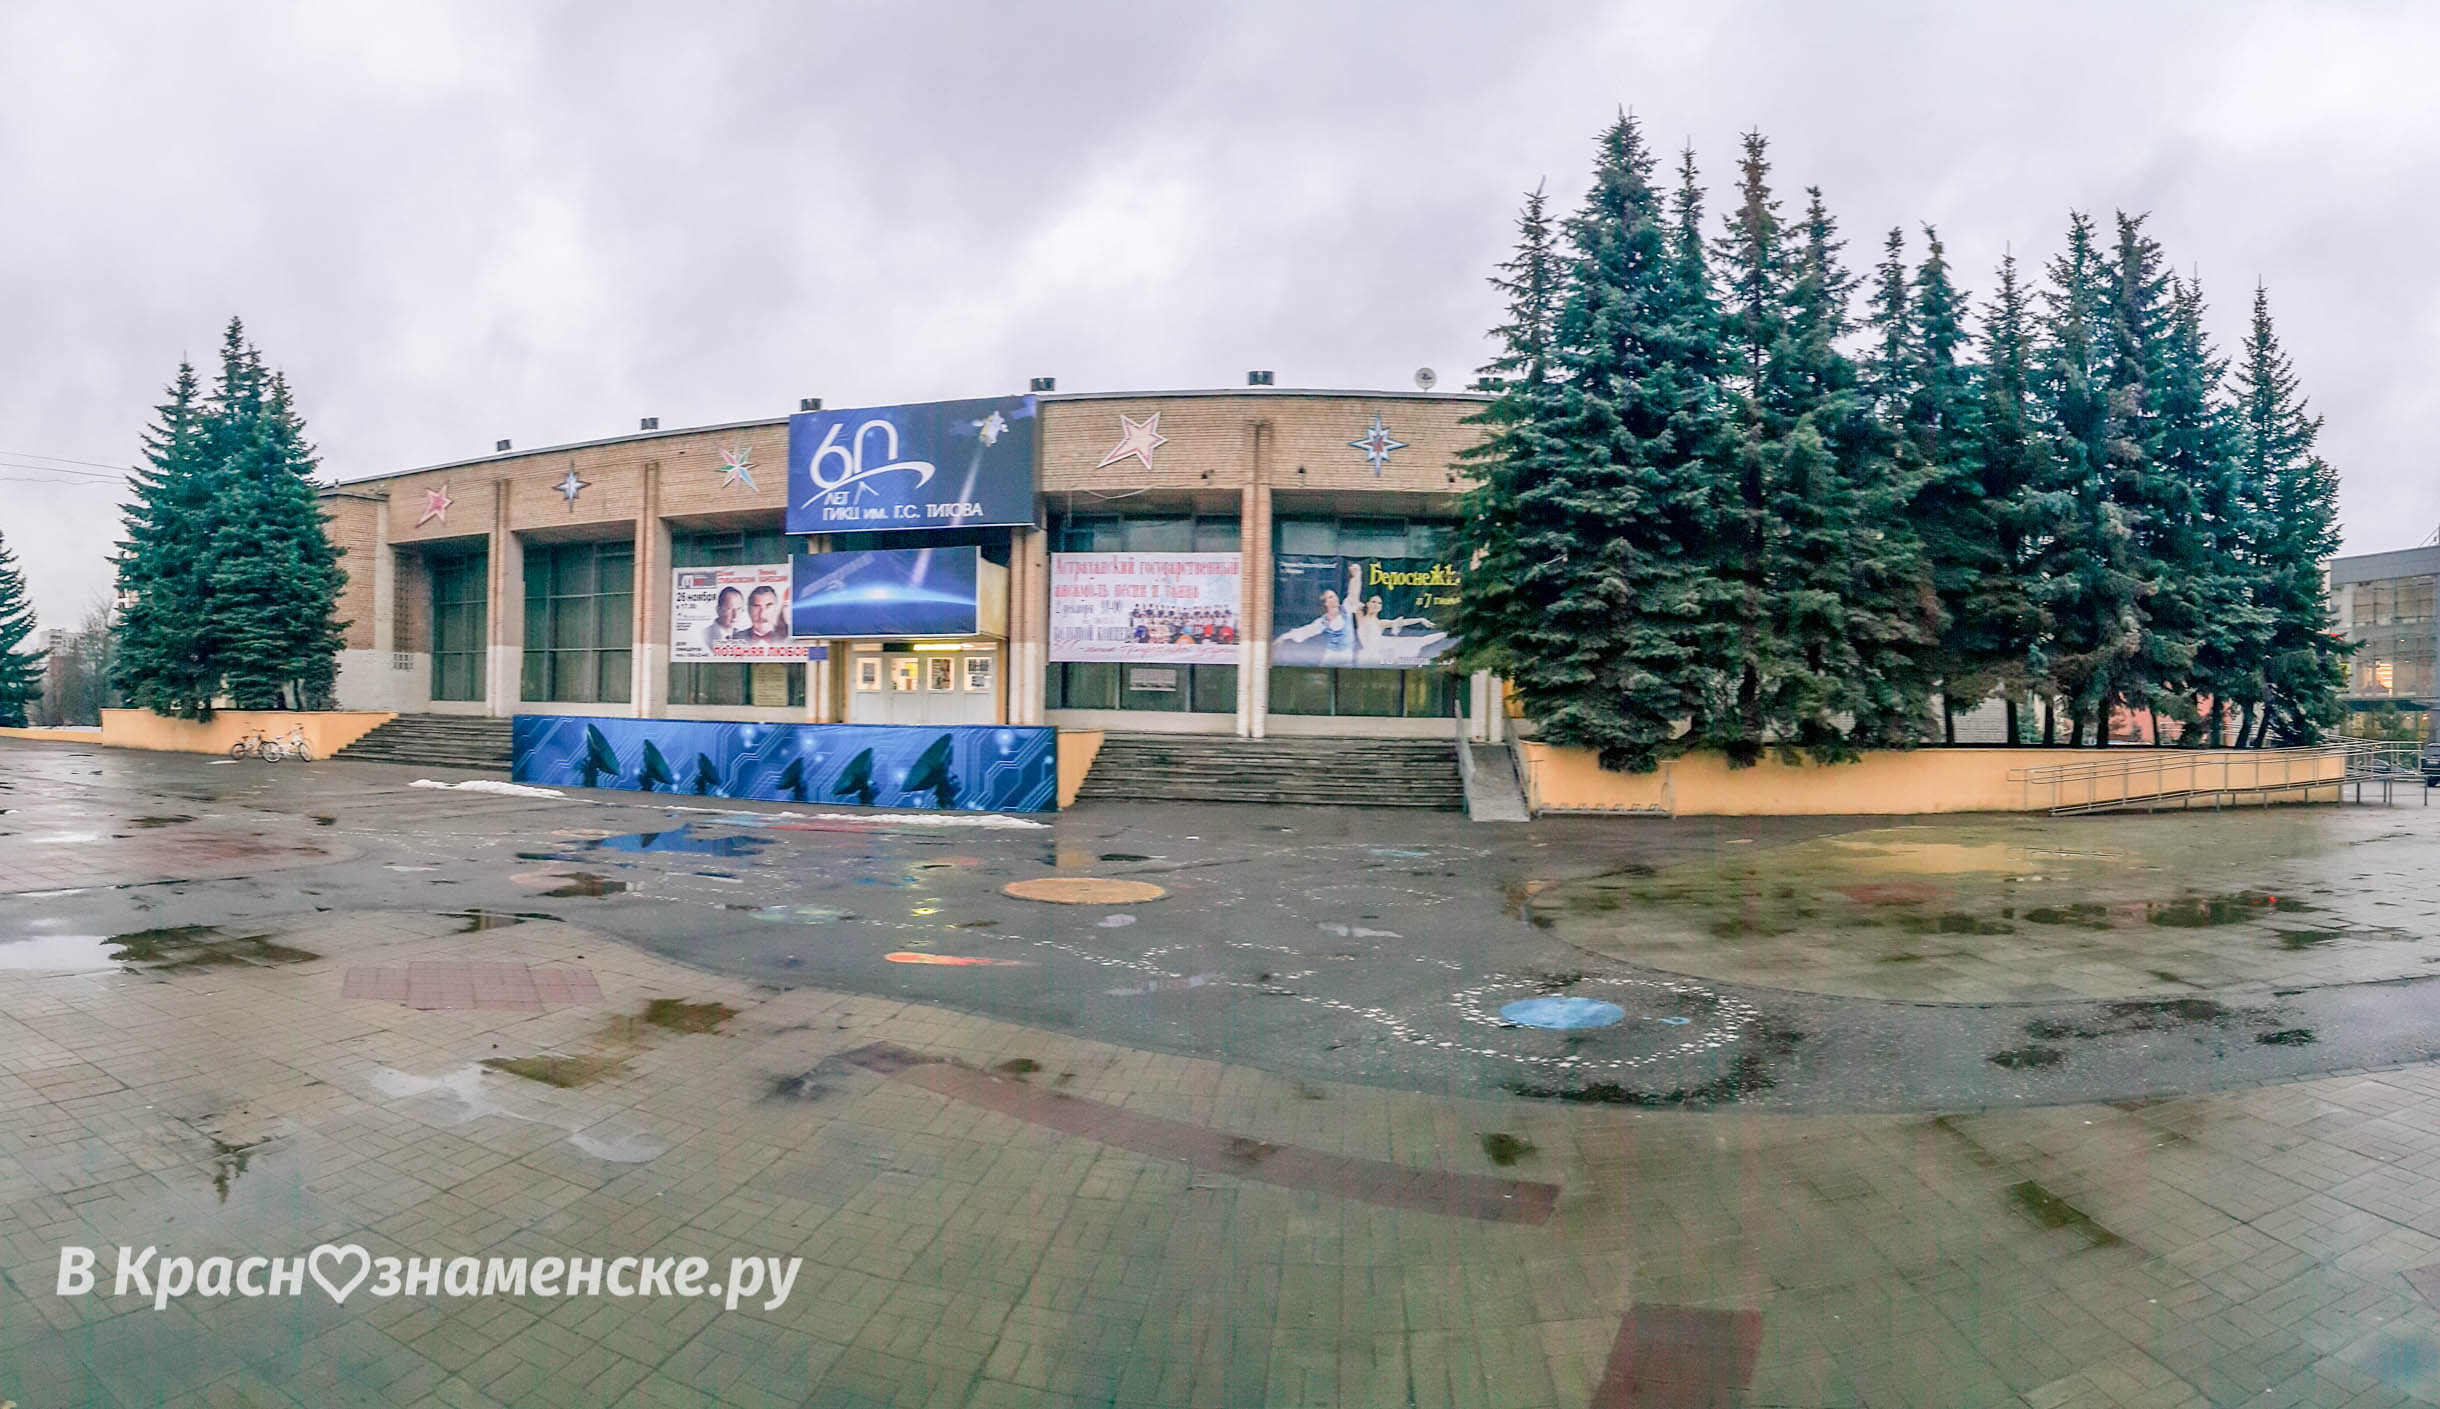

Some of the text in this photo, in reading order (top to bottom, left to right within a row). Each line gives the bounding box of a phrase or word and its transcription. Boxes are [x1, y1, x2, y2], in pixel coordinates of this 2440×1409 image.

[823, 491, 850, 505] ЛЕТ
[925, 502, 984, 518] ТИТОВА
[687, 591, 717, 603] ноября
[1423, 593, 1433, 608] 7
[713, 646, 764, 659] ПОЗДНЯЯ
[767, 646, 809, 657] ЛЮБОВ
